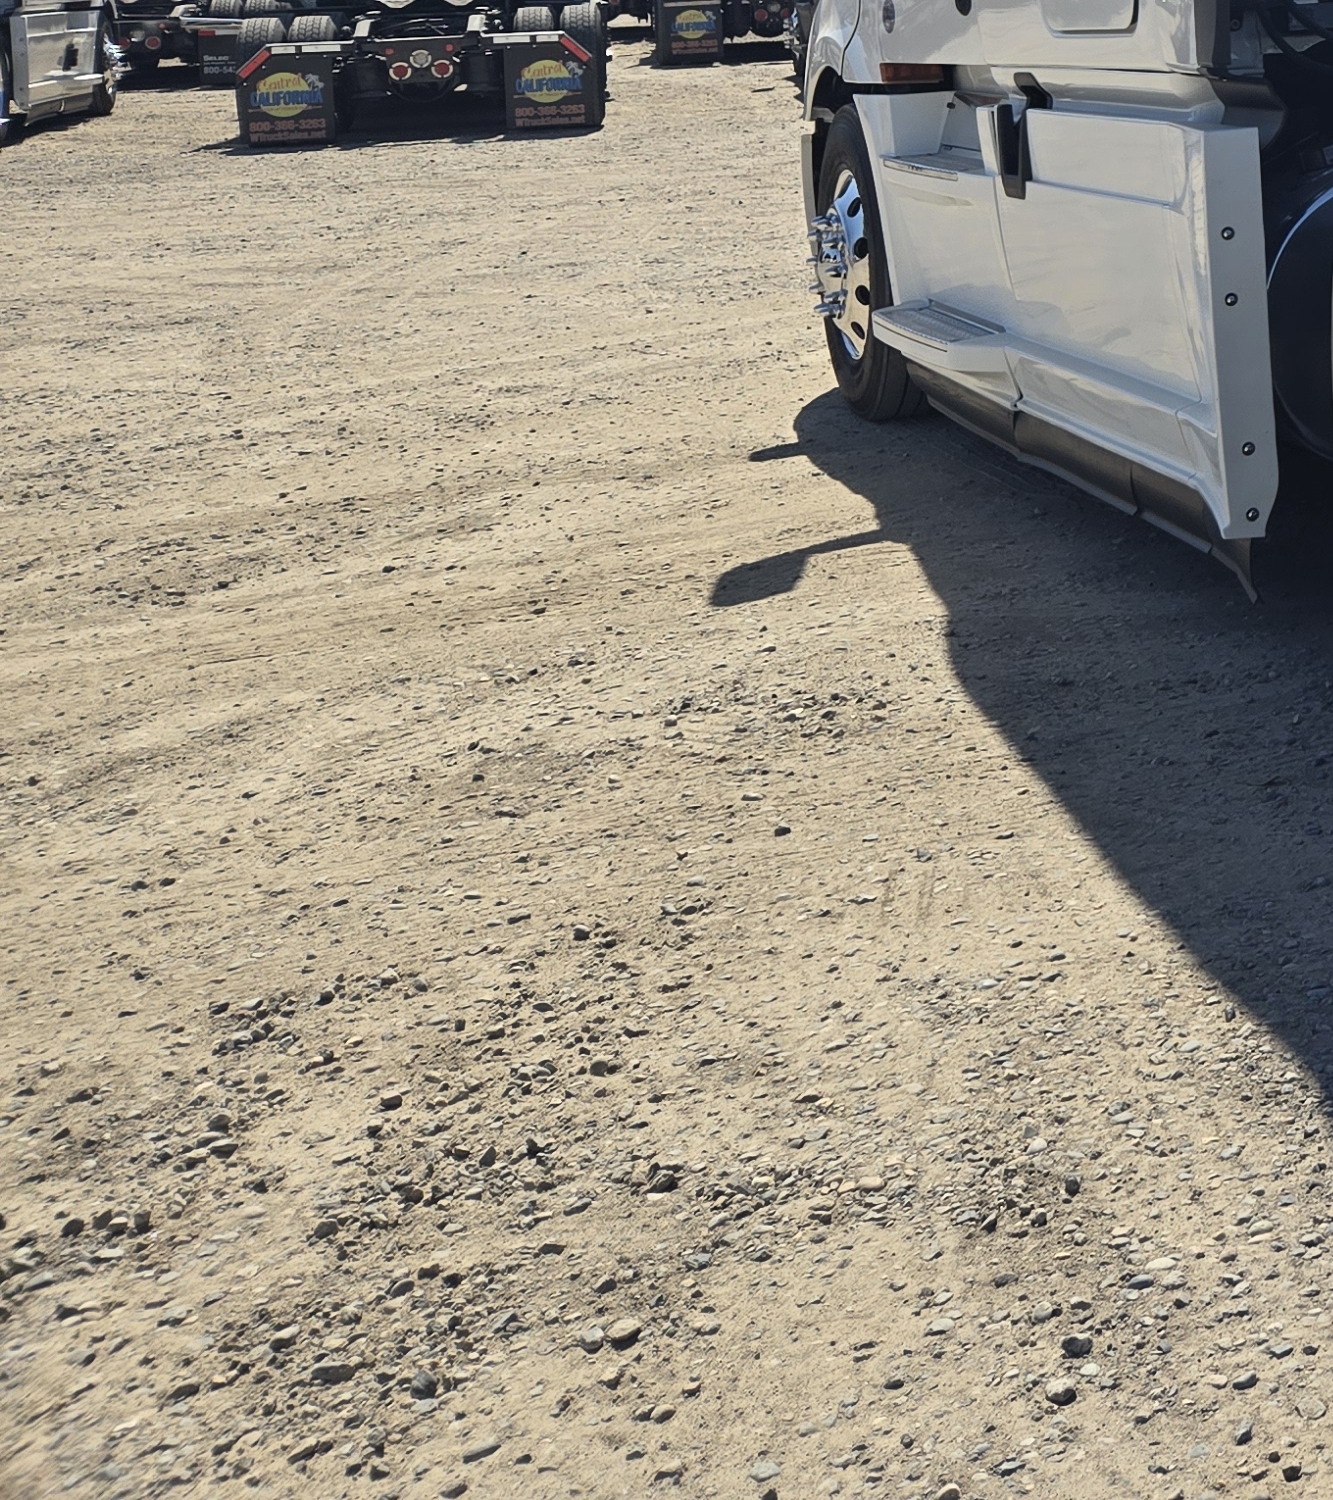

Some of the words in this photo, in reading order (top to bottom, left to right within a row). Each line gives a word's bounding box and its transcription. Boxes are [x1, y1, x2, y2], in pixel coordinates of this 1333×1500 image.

[520, 60, 563, 79] Central
[256, 72, 302, 92] Central
[515, 77, 583, 93] CALIFORNIA
[250, 89, 323, 107] CALIFORNIA
